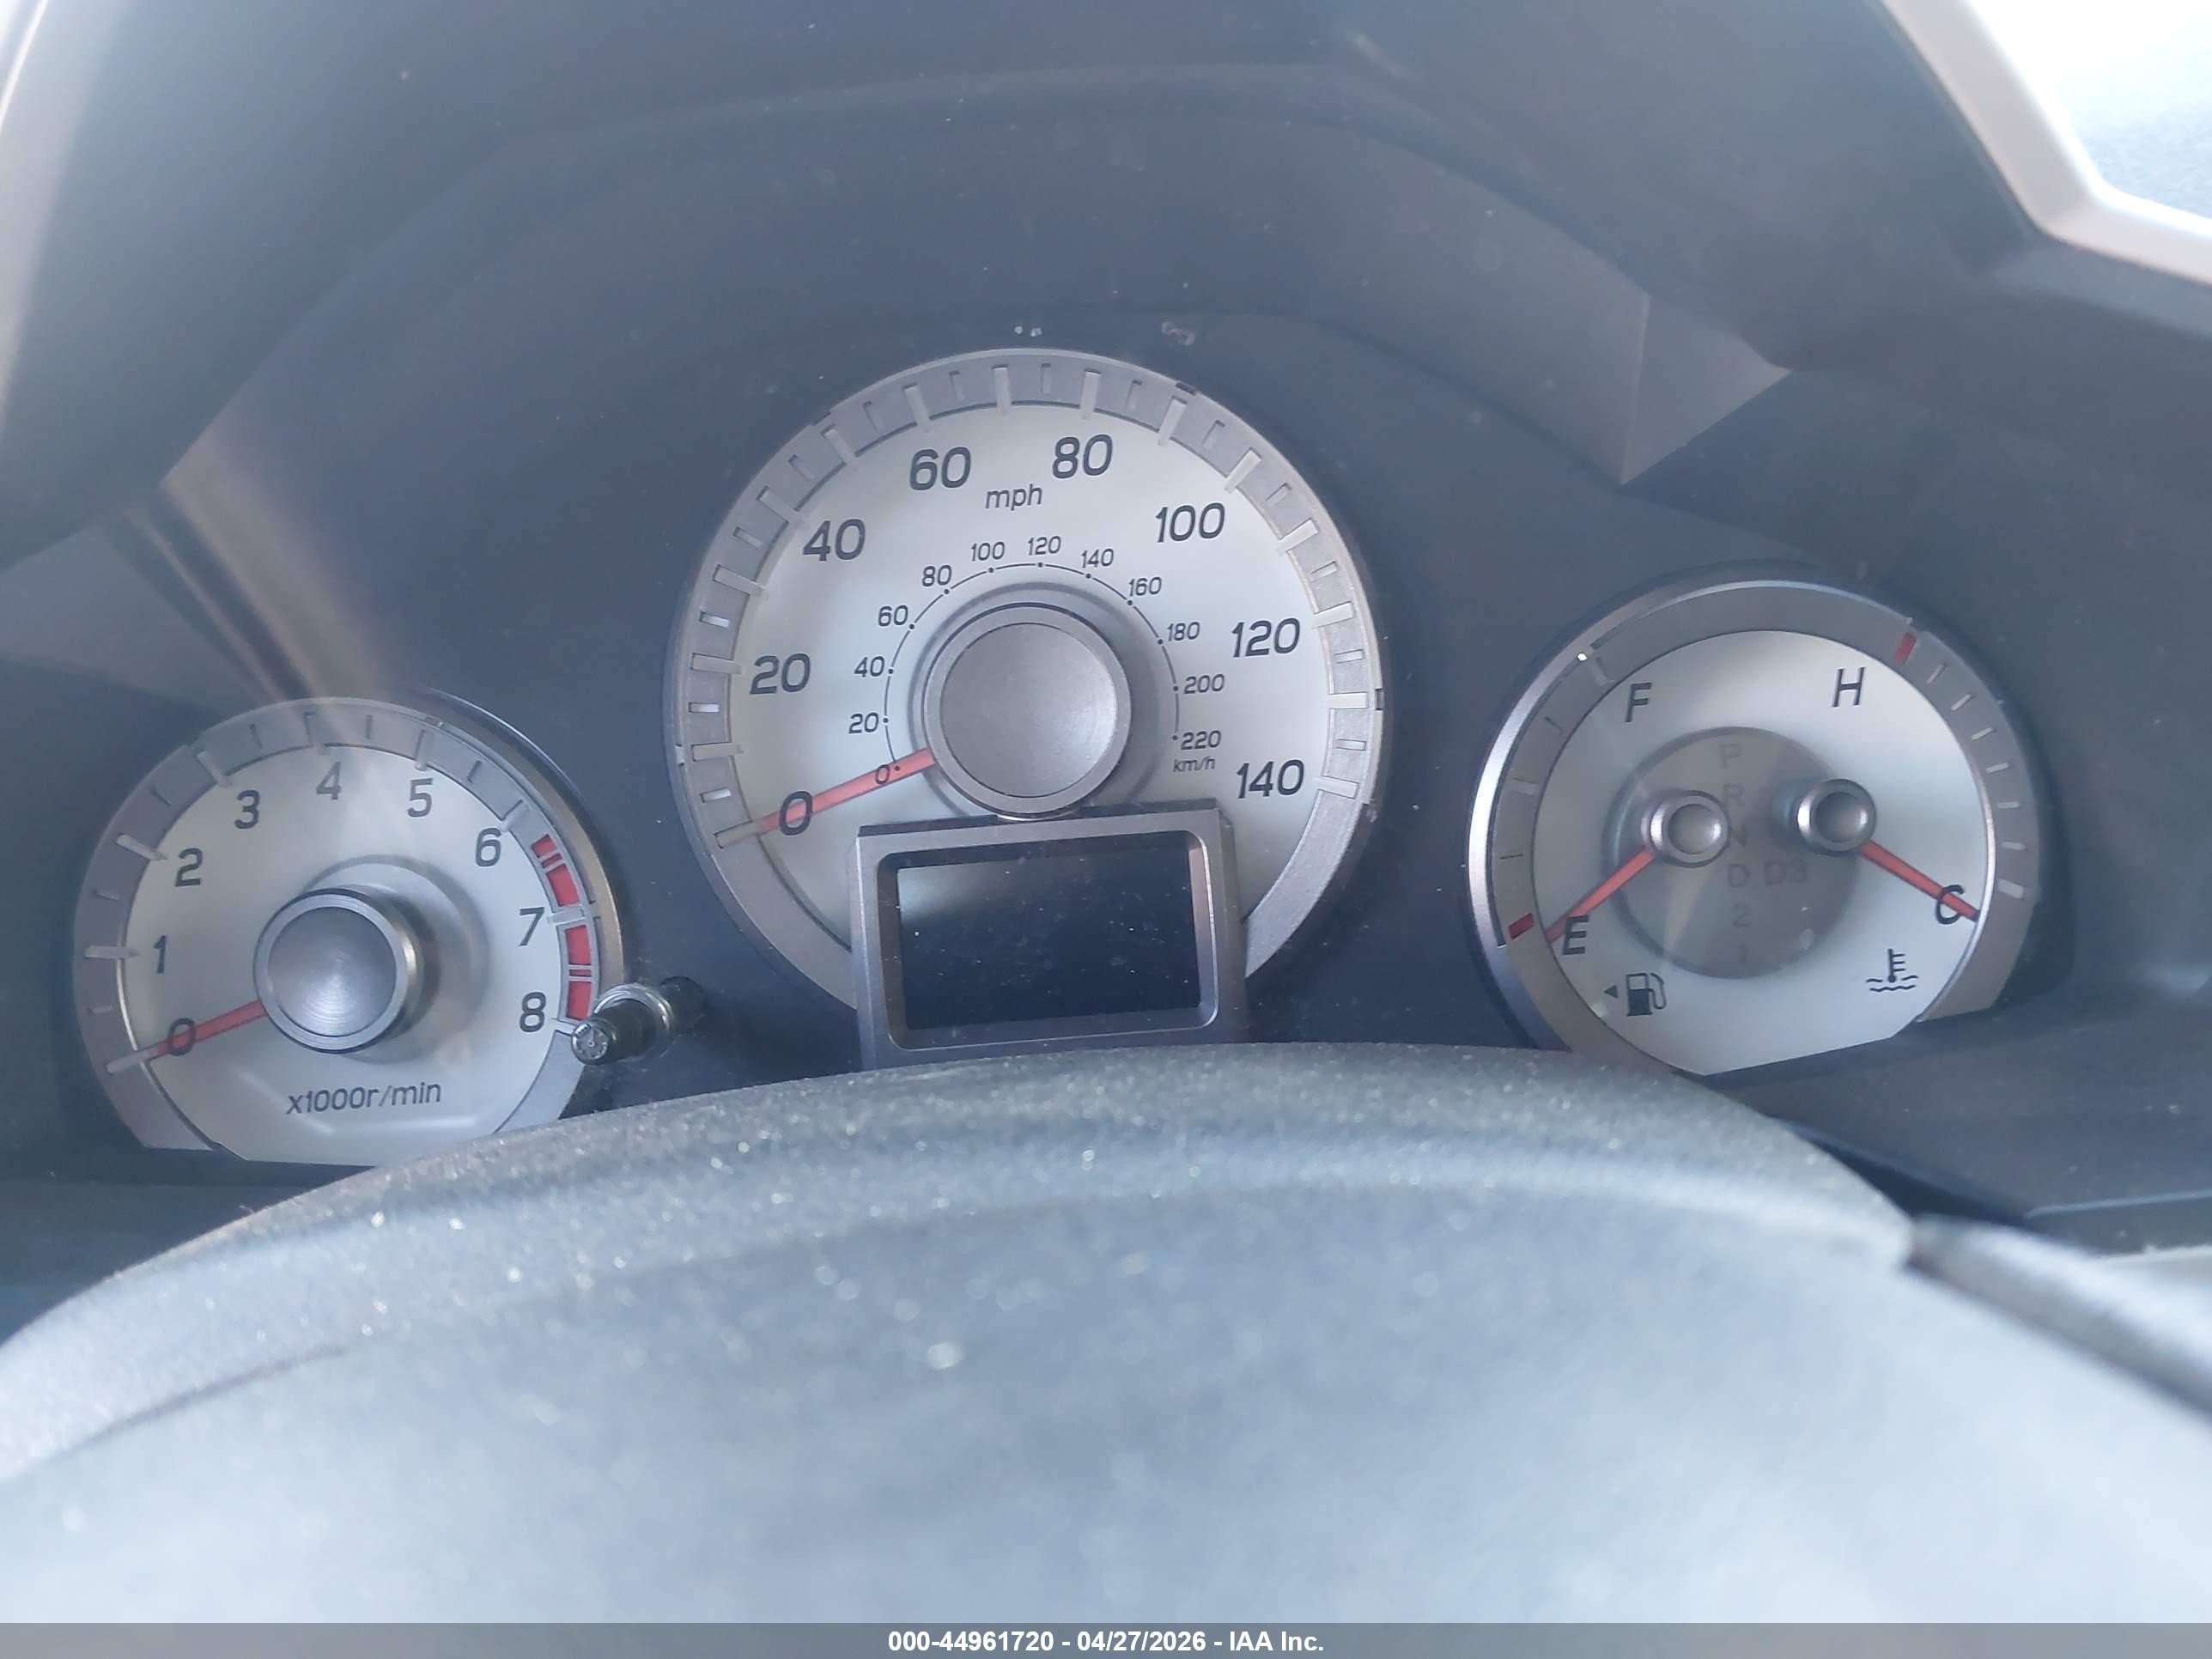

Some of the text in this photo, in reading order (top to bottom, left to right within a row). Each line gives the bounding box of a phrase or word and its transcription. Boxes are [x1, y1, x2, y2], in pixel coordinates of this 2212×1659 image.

[908, 447, 972, 490] 60
[1052, 434, 1114, 479] 80
[985, 483, 1042, 511] mph
[803, 519, 866, 561] 40
[1155, 501, 1225, 543] 100
[970, 541, 1006, 562] 100
[1028, 535, 1061, 556] 120
[1080, 548, 1115, 568] 140
[921, 564, 953, 586] 80
[1128, 576, 1162, 597] 160
[878, 605, 908, 627] 60
[1167, 622, 1200, 642] 180
[1231, 617, 1300, 658] 120
[750, 653, 811, 695] 20
[854, 656, 885, 678] 40
[1184, 674, 1225, 694] 200
[1626, 682, 1653, 722] F
[1832, 667, 1865, 708] H
[848, 713, 879, 734] 20
[1181, 730, 1221, 750] 220
[316, 761, 342, 800] 4
[875, 763, 890, 785] 0
[1173, 755, 1215, 773] km/h
[1237, 759, 1304, 799] 140
[235, 789, 260, 830] 3
[407, 778, 434, 817] 5
[780, 791, 812, 836] 0
[476, 827, 501, 867] 6
[174, 848, 204, 887] 2
[1935, 884, 1965, 925] C
[519, 907, 546, 947] 7
[1562, 915, 1590, 956] E
[153, 935, 167, 974] 1
[519, 992, 546, 1032] 8
[166, 1018, 197, 1057] 0
[286, 1081, 441, 1115] x1000r/min
